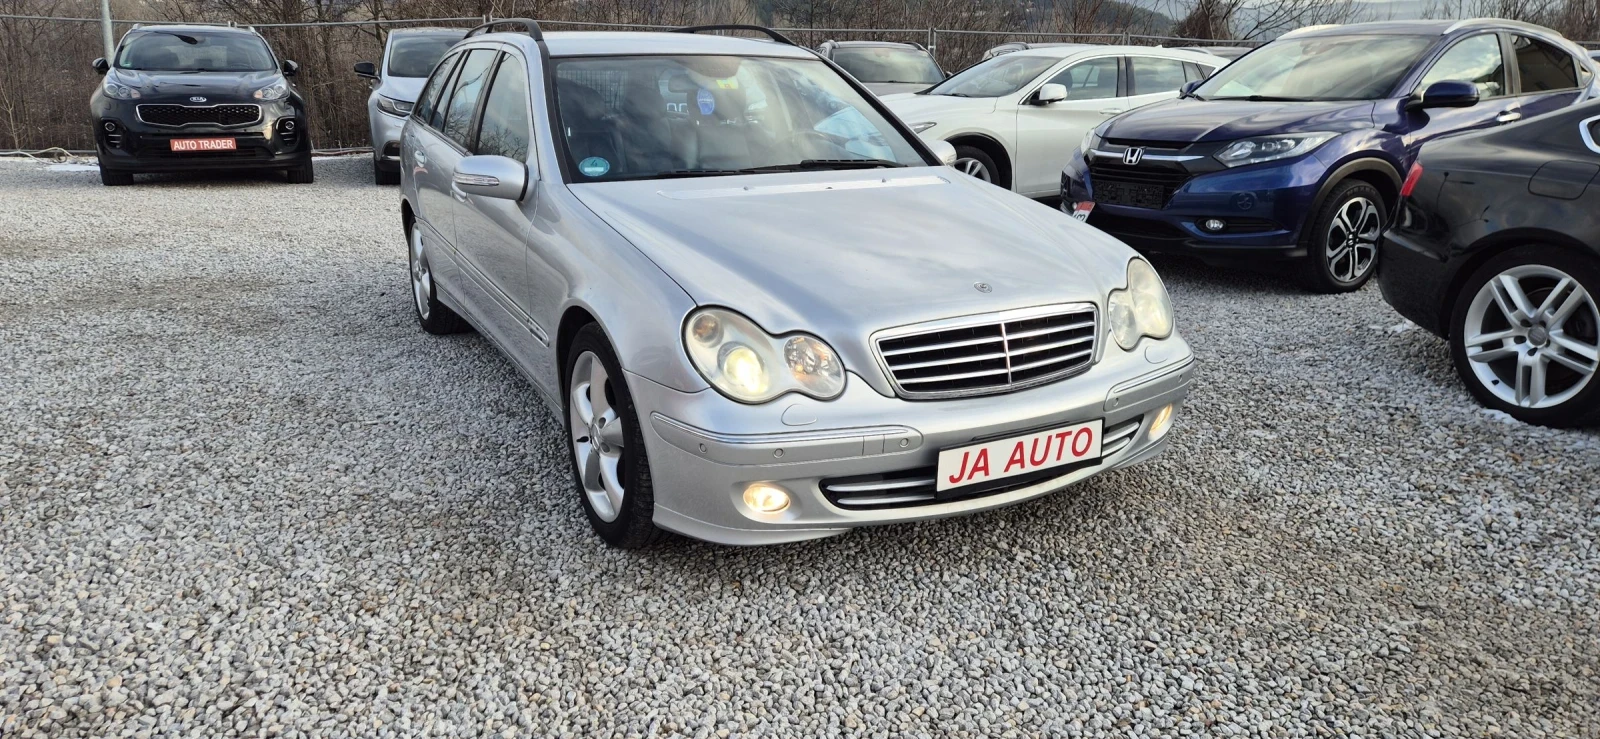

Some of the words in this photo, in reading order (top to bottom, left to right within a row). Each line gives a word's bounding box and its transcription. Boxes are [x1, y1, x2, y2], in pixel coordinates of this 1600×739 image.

[174, 140, 197, 150] AUTO
[198, 139, 234, 149] TRADER
[948, 448, 990, 484] JA
[1003, 427, 1093, 473] AUTO
